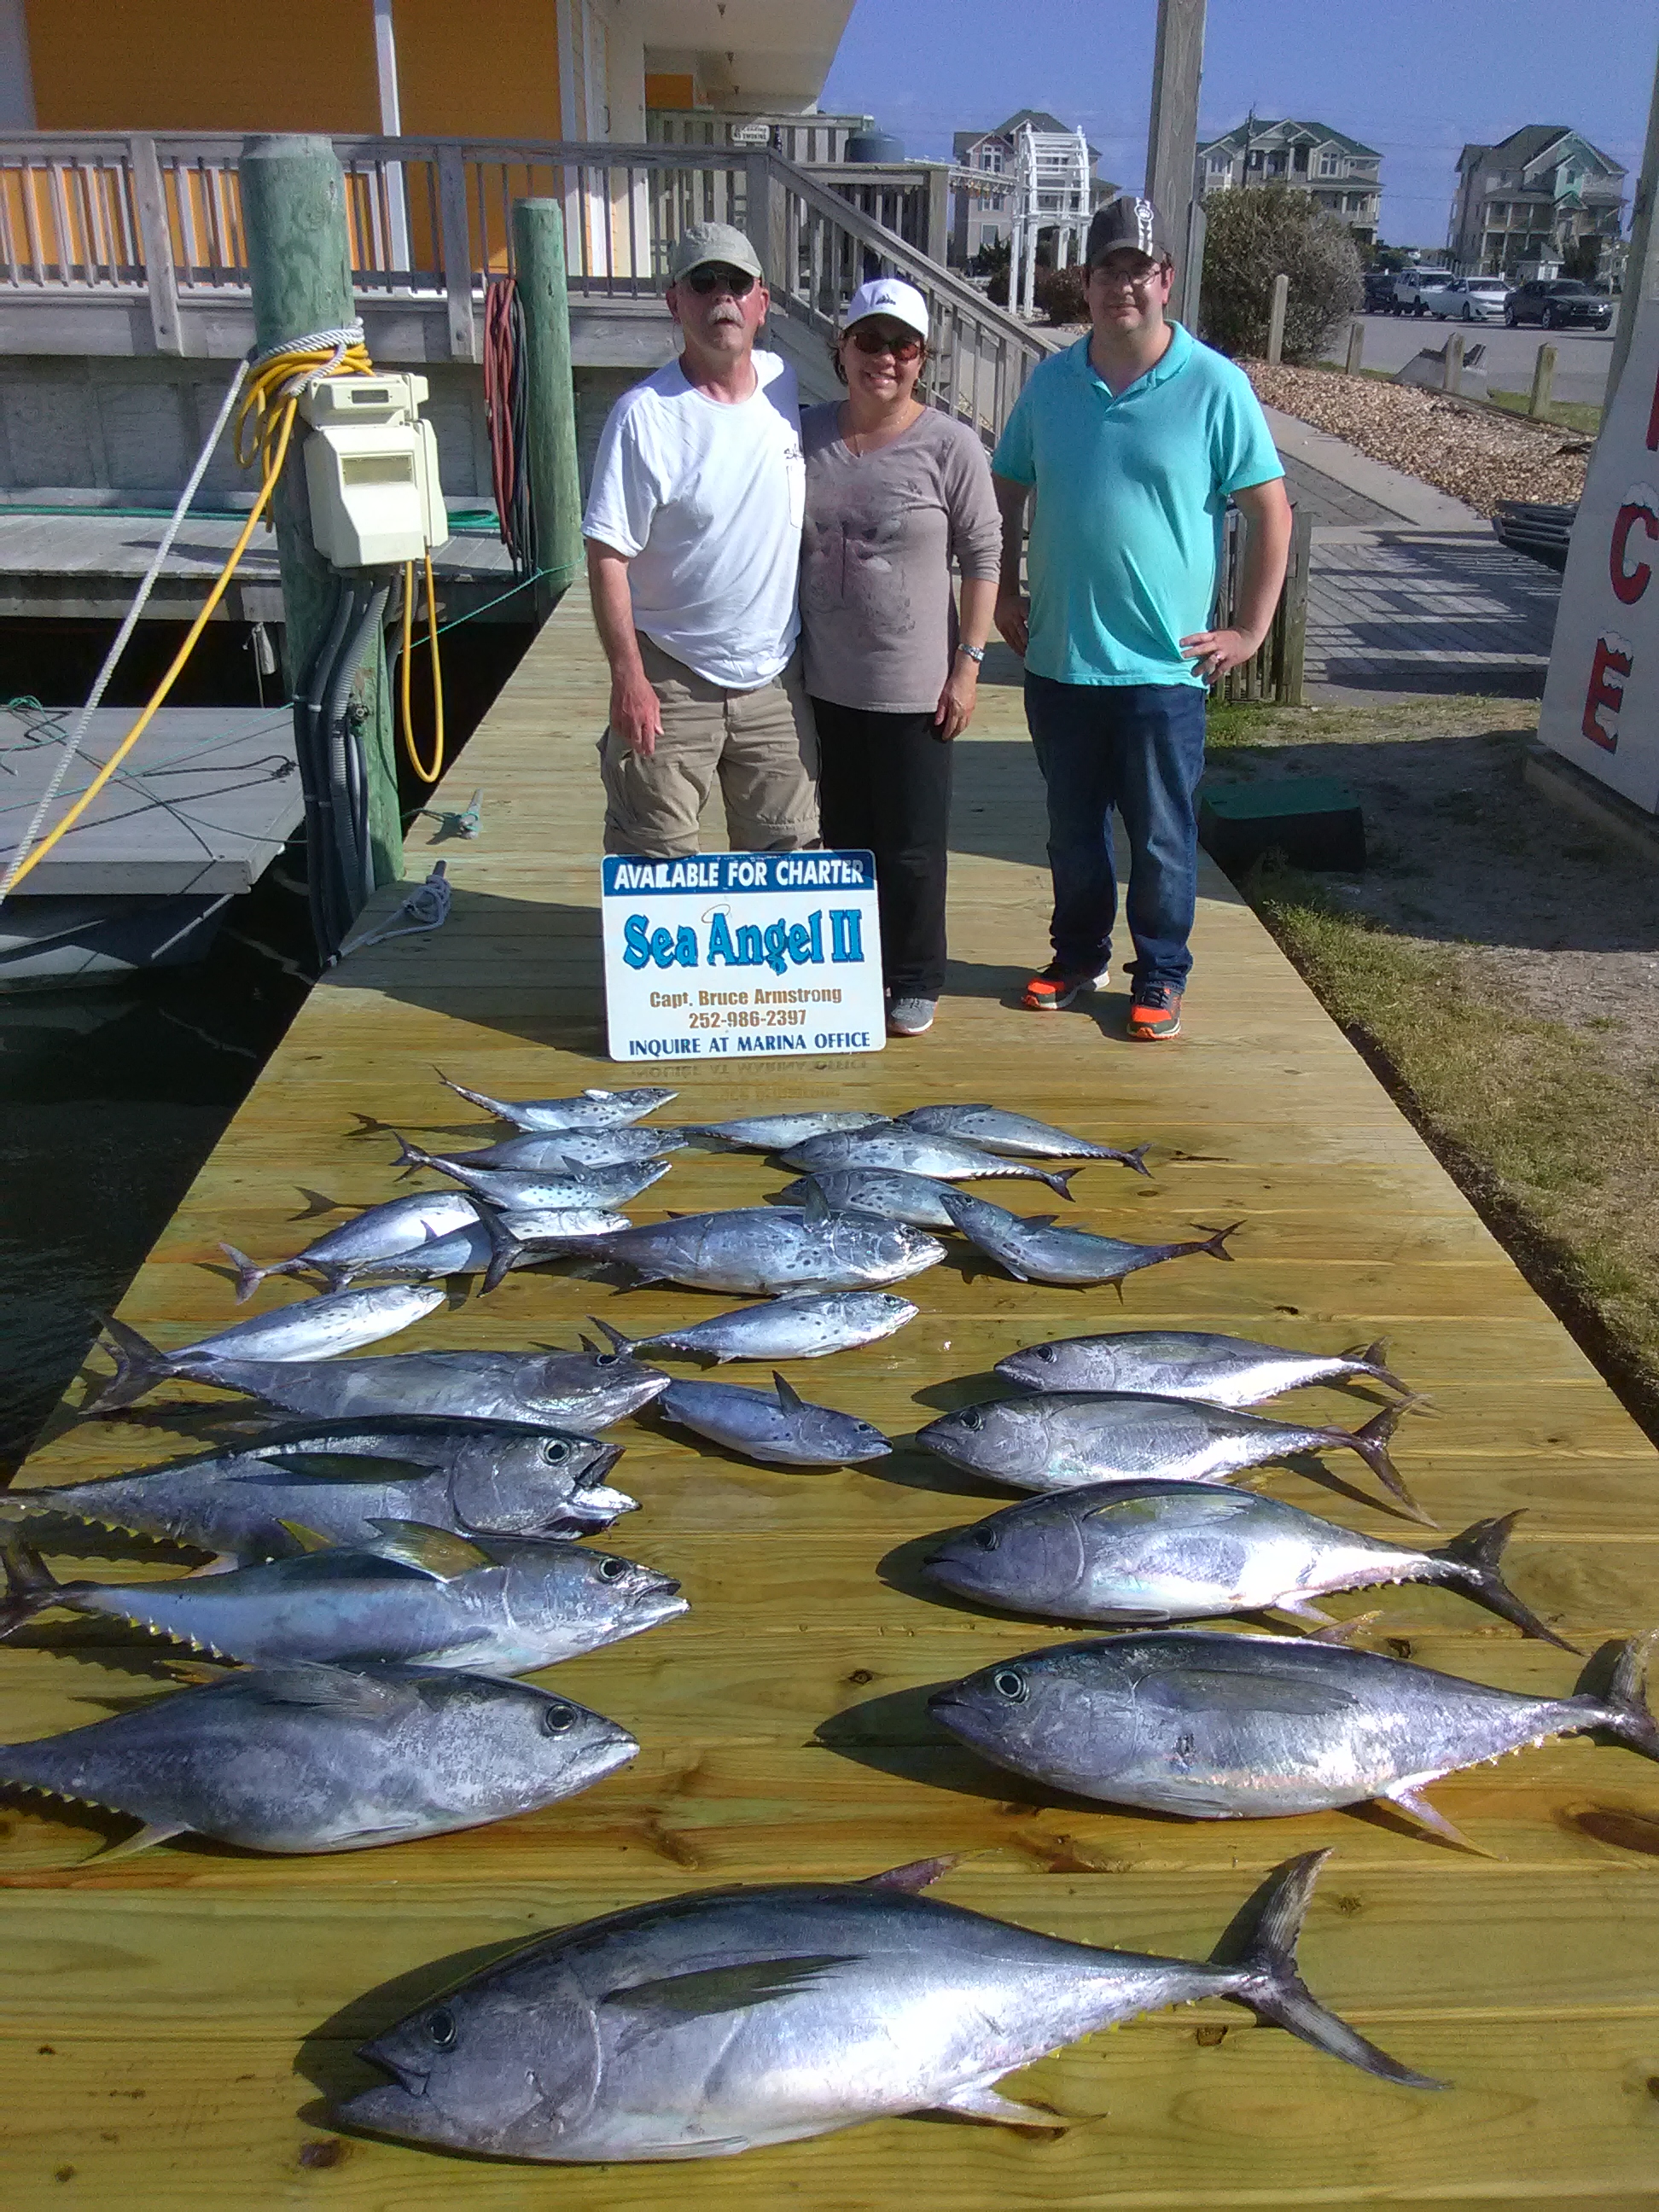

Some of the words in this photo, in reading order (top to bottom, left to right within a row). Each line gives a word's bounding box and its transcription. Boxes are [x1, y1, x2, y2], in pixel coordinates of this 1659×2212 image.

[614, 861, 719, 890] AVAILABLE
[728, 861, 767, 887] FOR
[776, 859, 864, 886] CHARTER
[623, 914, 699, 969] Sea
[707, 909, 823, 976] Angel
[829, 909, 864, 963] II
[649, 991, 694, 1008] Capt.
[698, 989, 748, 1006] Bruce
[754, 987, 842, 1005] Armstrong
[689, 1010, 806, 1029] 252-986-2397
[629, 1038, 701, 1057] INQUIRE
[708, 1038, 730, 1053] AT
[736, 1034, 806, 1051] MARINA
[814, 1032, 870, 1049] OFFICE
